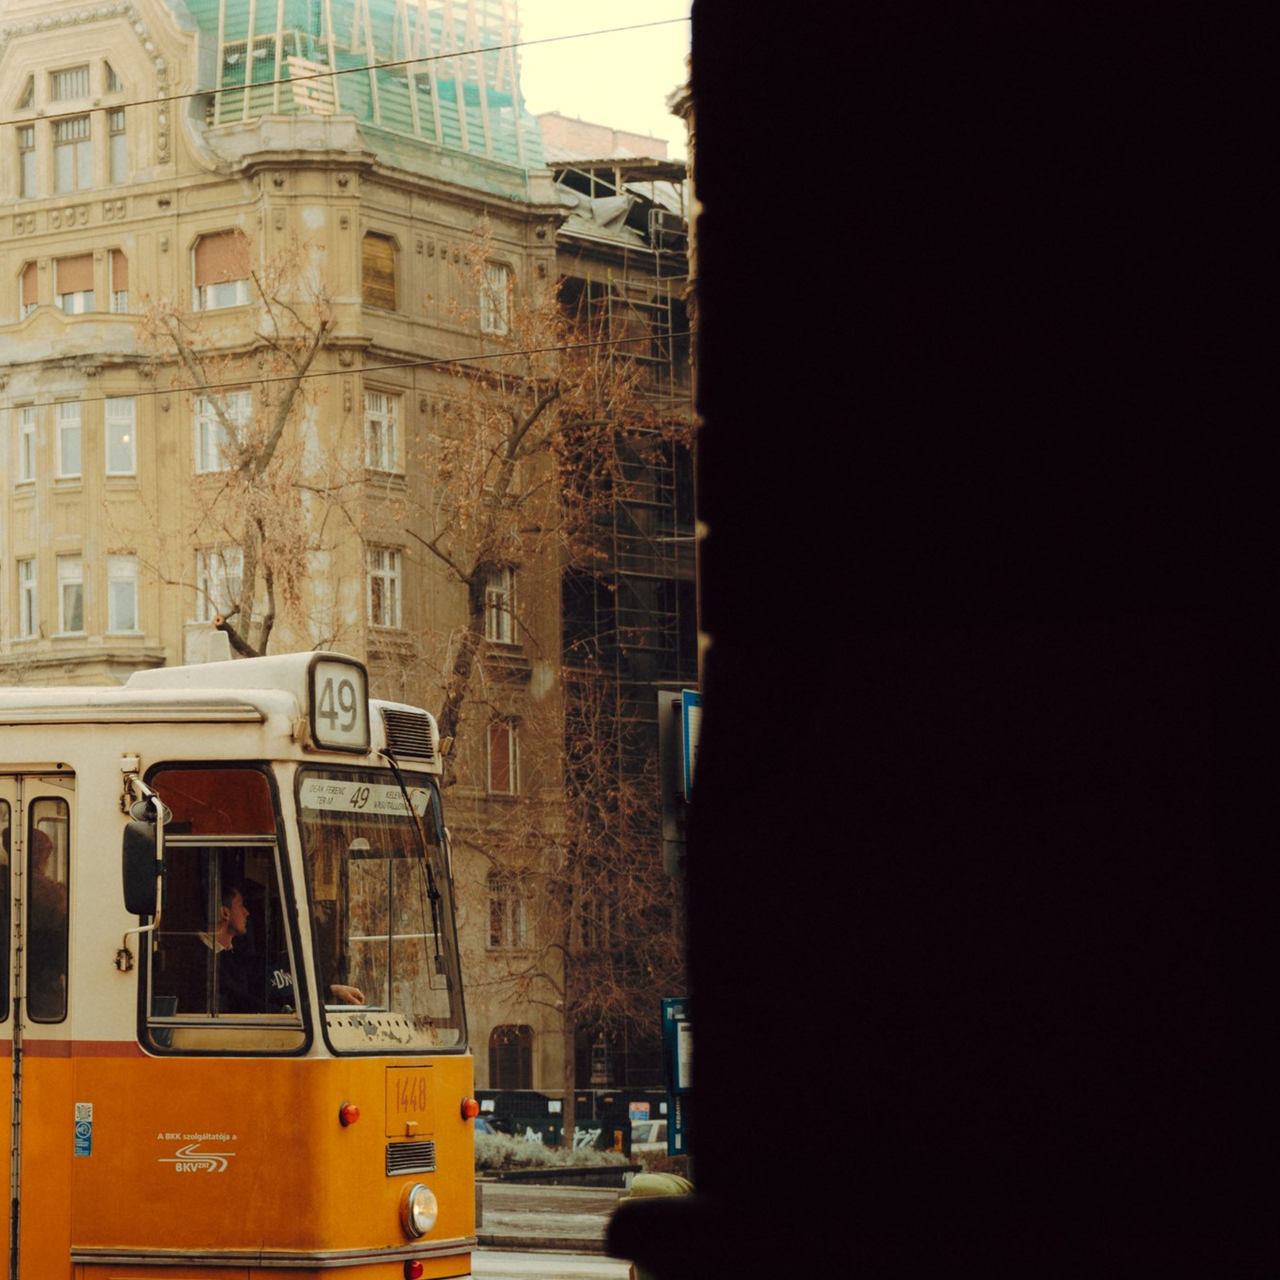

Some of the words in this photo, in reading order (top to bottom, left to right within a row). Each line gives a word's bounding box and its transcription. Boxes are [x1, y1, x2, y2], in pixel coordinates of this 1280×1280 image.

[317, 677, 357, 733] 49
[325, 784, 346, 796] FERENC
[349, 786, 371, 810] 49
[395, 1076, 427, 1114] 1448
[157, 1132, 164, 1140] A
[175, 1162, 198, 1172] BKV
